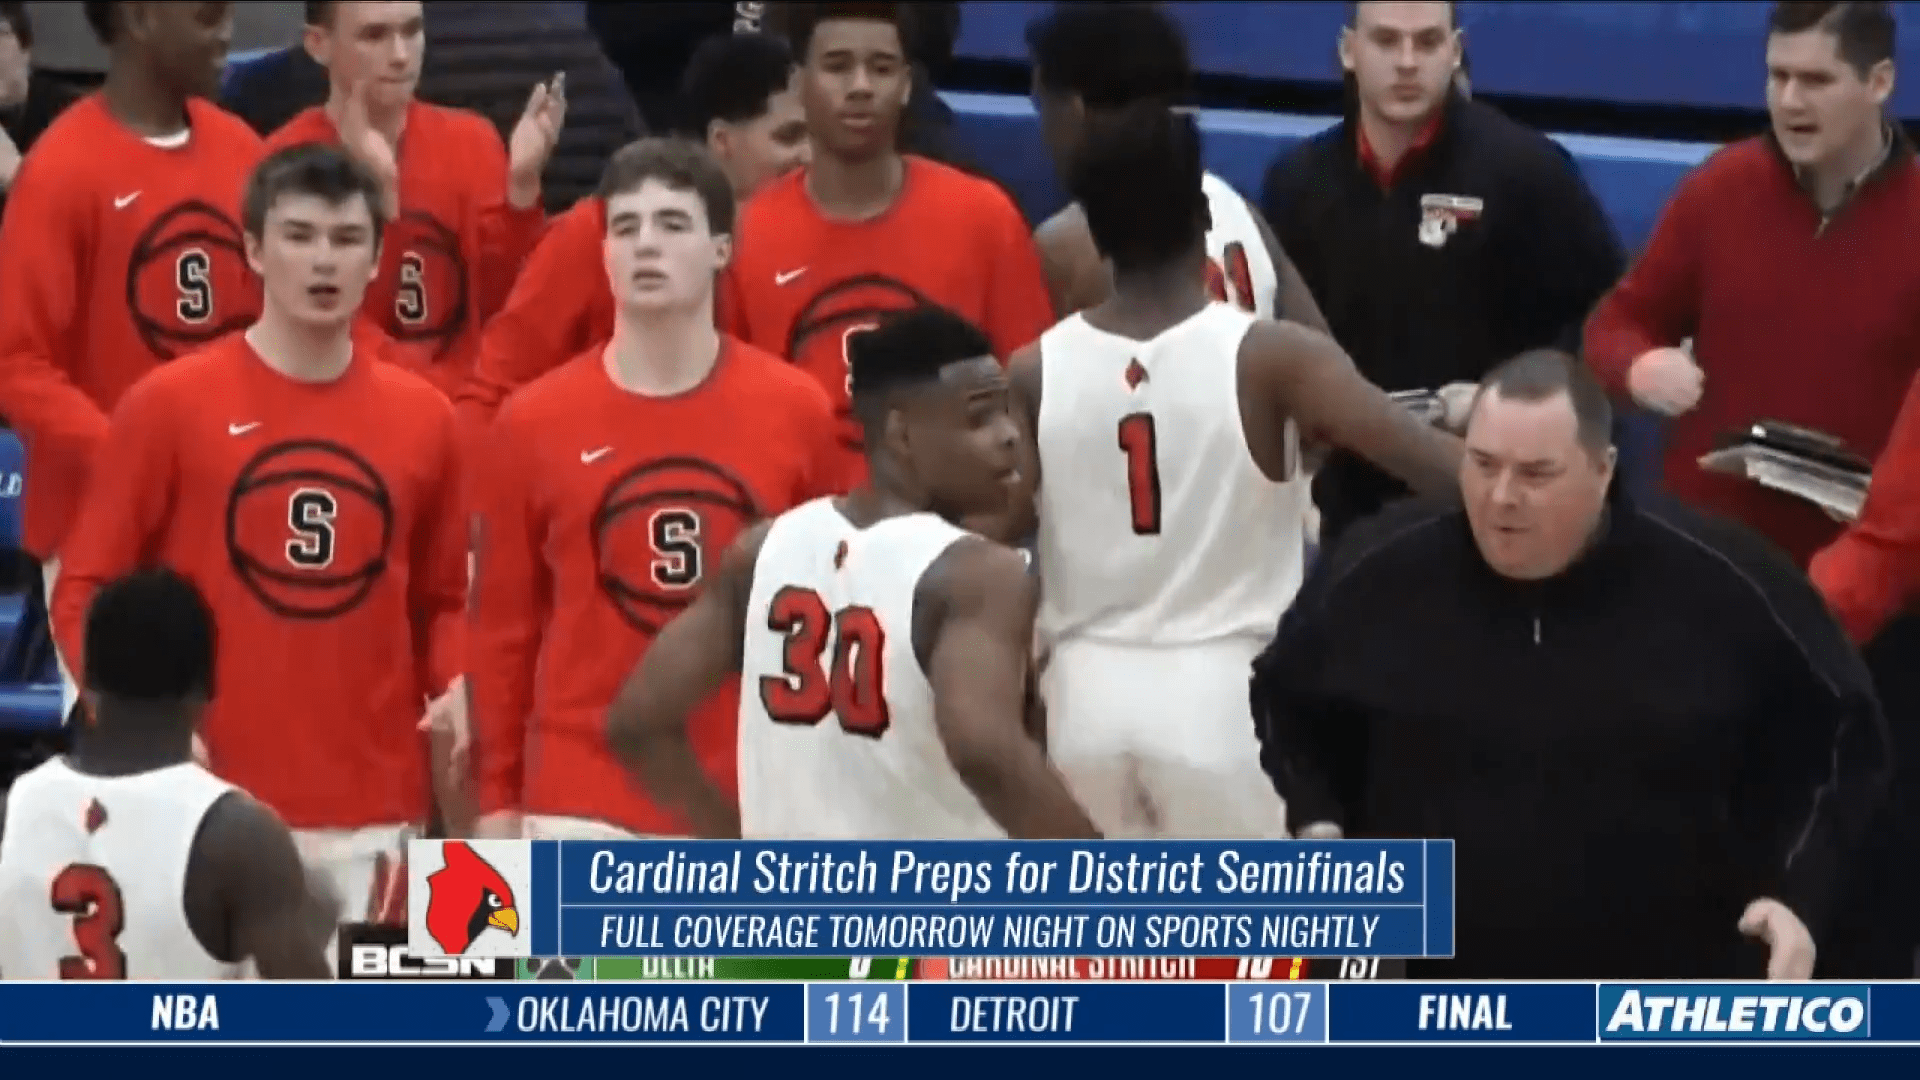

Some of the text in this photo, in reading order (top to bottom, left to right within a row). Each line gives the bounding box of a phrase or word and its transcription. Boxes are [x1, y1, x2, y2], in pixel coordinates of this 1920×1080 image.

[176, 247, 213, 324] S
[1117, 412, 1162, 536] 1
[285, 487, 337, 570] S
[648, 507, 703, 591] S
[759, 584, 890, 741] 30
[51, 863, 128, 980] 3
